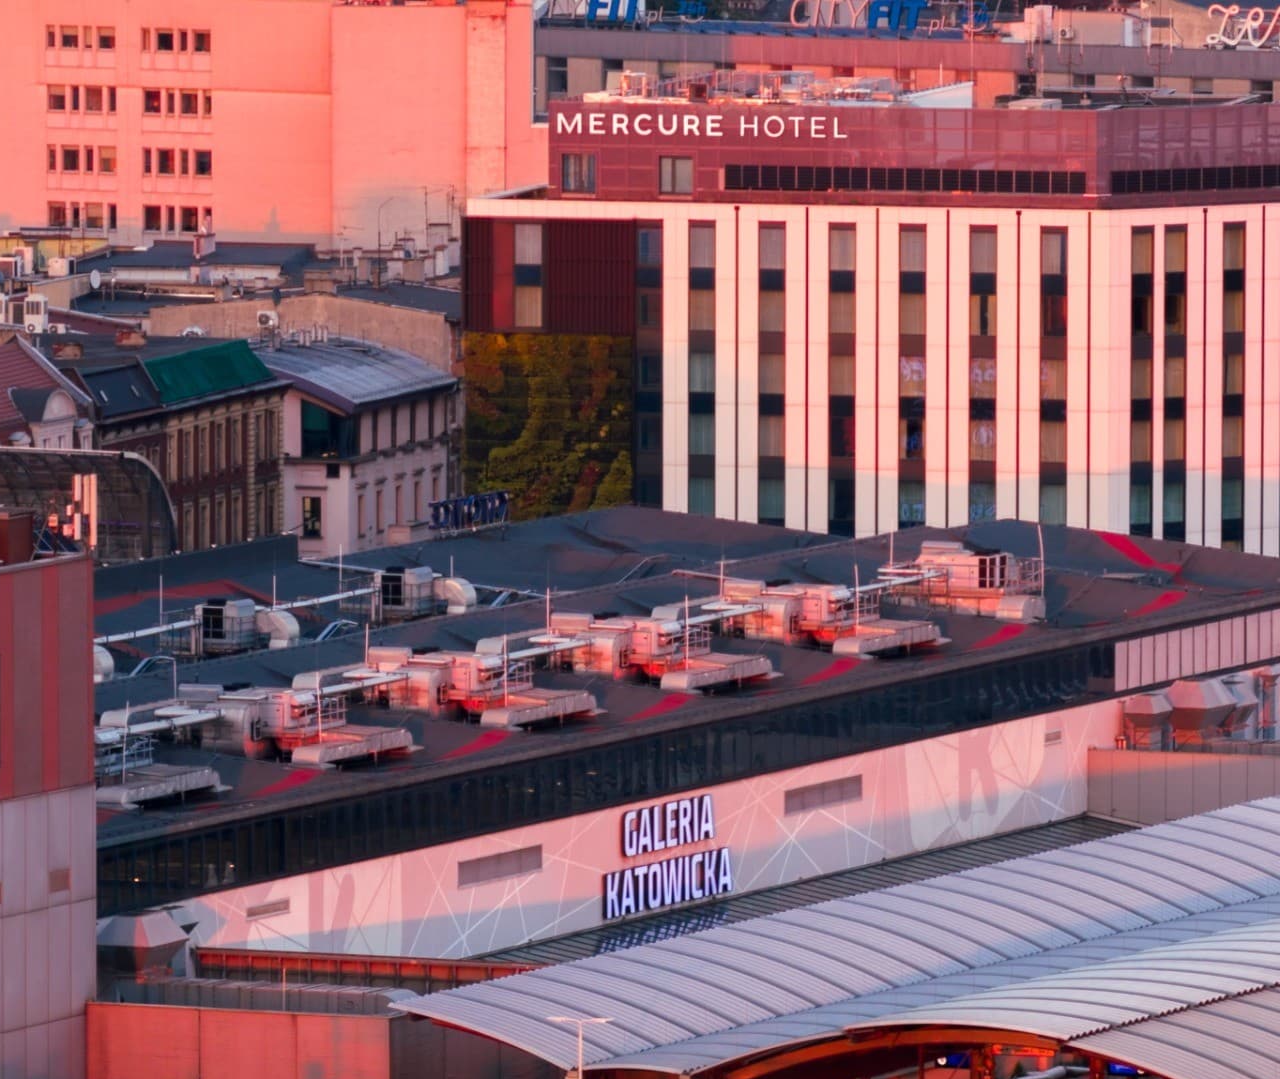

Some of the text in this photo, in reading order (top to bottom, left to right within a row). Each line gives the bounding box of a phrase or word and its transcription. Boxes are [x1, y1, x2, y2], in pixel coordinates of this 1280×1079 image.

[789, 0, 928, 32] CITYFIT
[555, 111, 849, 139] MERCURE HOTEL
[622, 794, 715, 858] GALERIA
[604, 847, 734, 920] KATOWICKA
